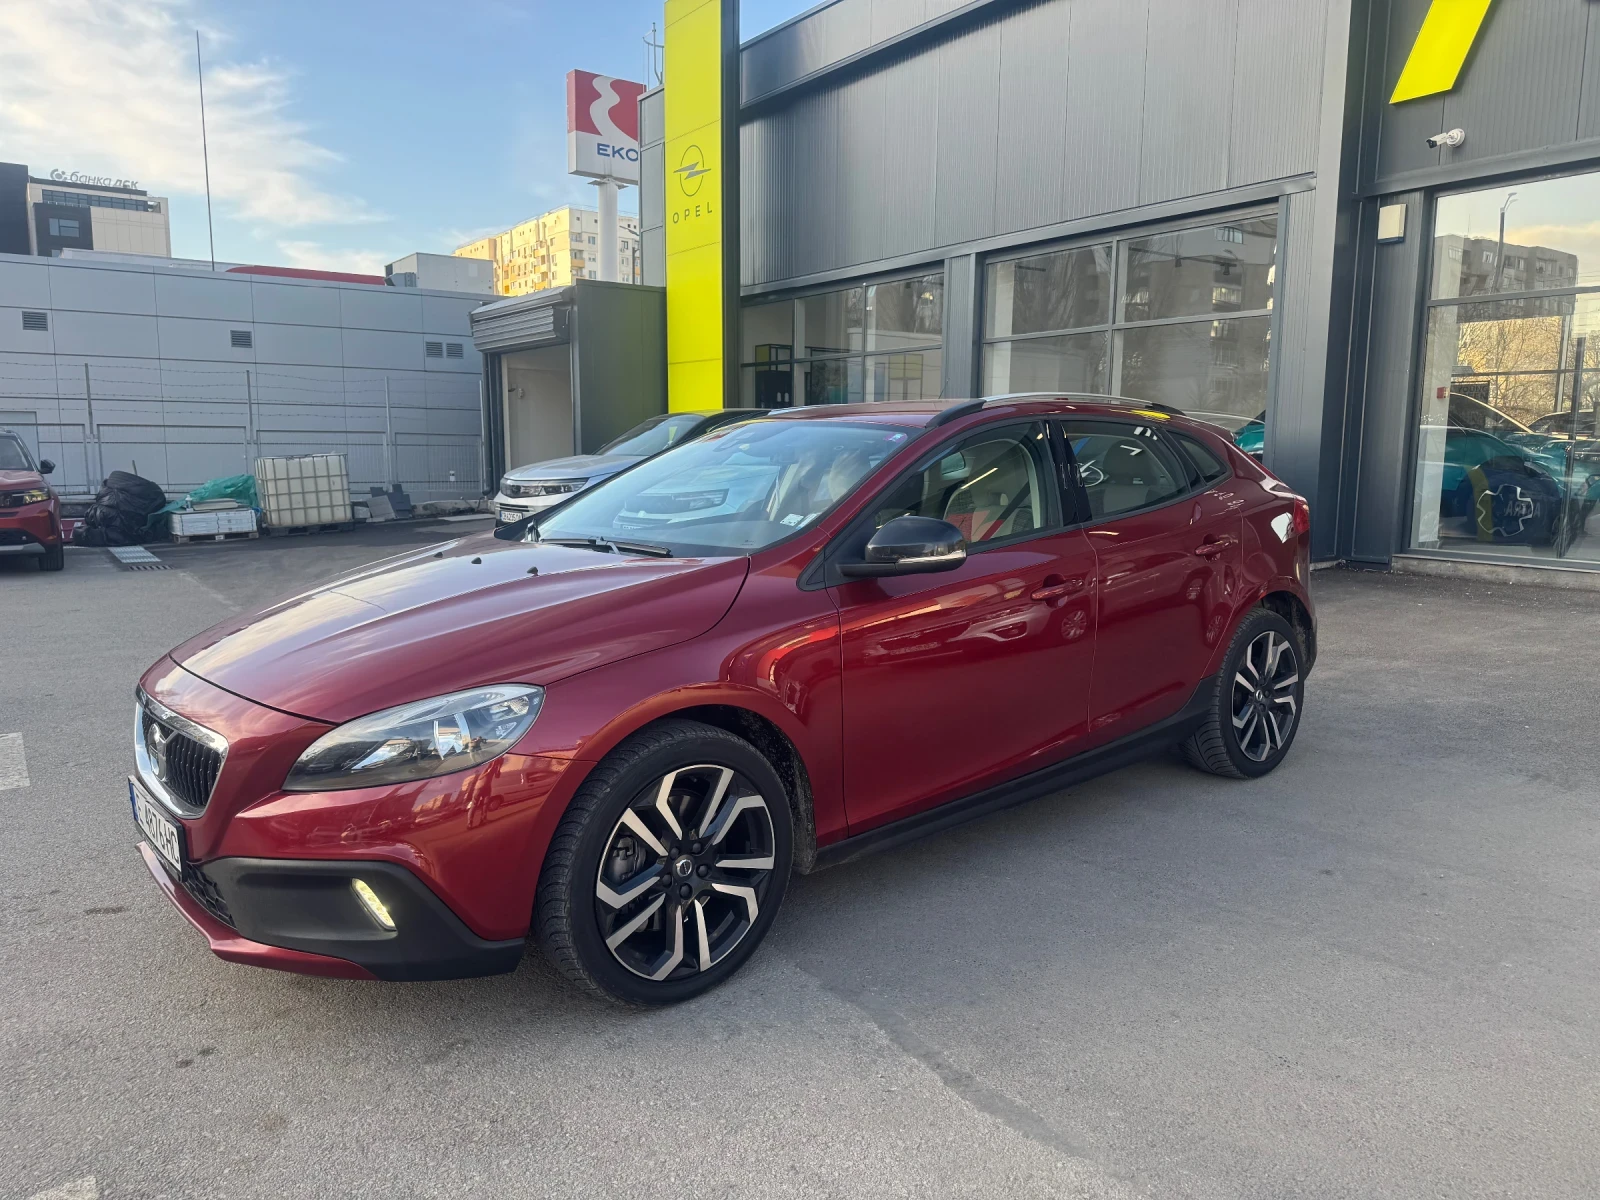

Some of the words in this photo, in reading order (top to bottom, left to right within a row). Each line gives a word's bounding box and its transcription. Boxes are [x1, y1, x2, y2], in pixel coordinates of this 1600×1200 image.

[596, 142, 639, 162] EKO
[70, 171, 111, 187] банка
[672, 201, 713, 224] OPEL
